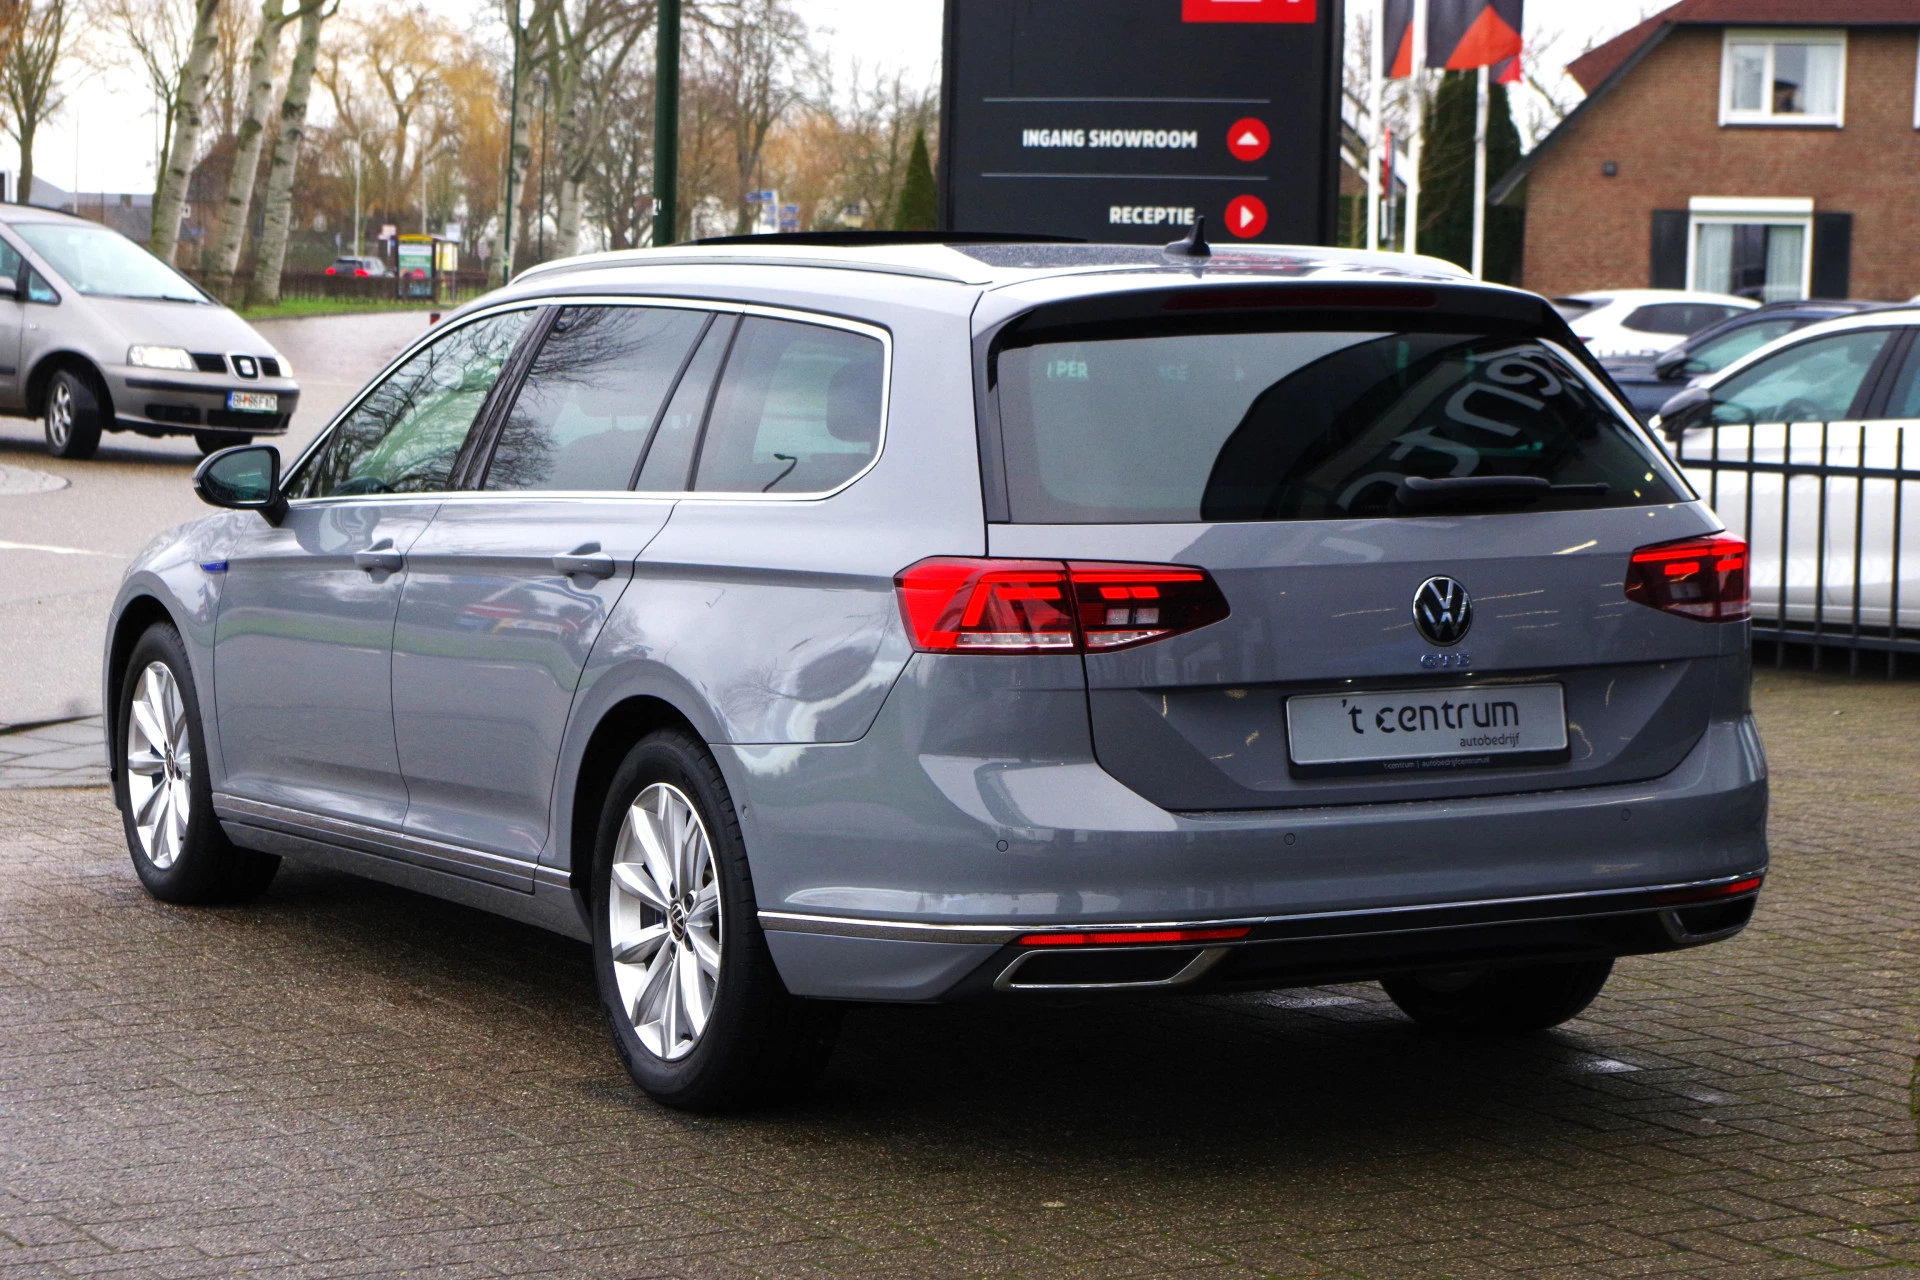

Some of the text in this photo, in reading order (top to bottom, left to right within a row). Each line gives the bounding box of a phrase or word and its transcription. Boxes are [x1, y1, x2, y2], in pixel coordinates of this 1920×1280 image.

[1023, 129, 1198, 149] INGANG SHOWROOM
[1109, 206, 1195, 225] RECEPTIE
[1375, 700, 1519, 734] centrum
[1459, 732, 1520, 748] autobedrijf
